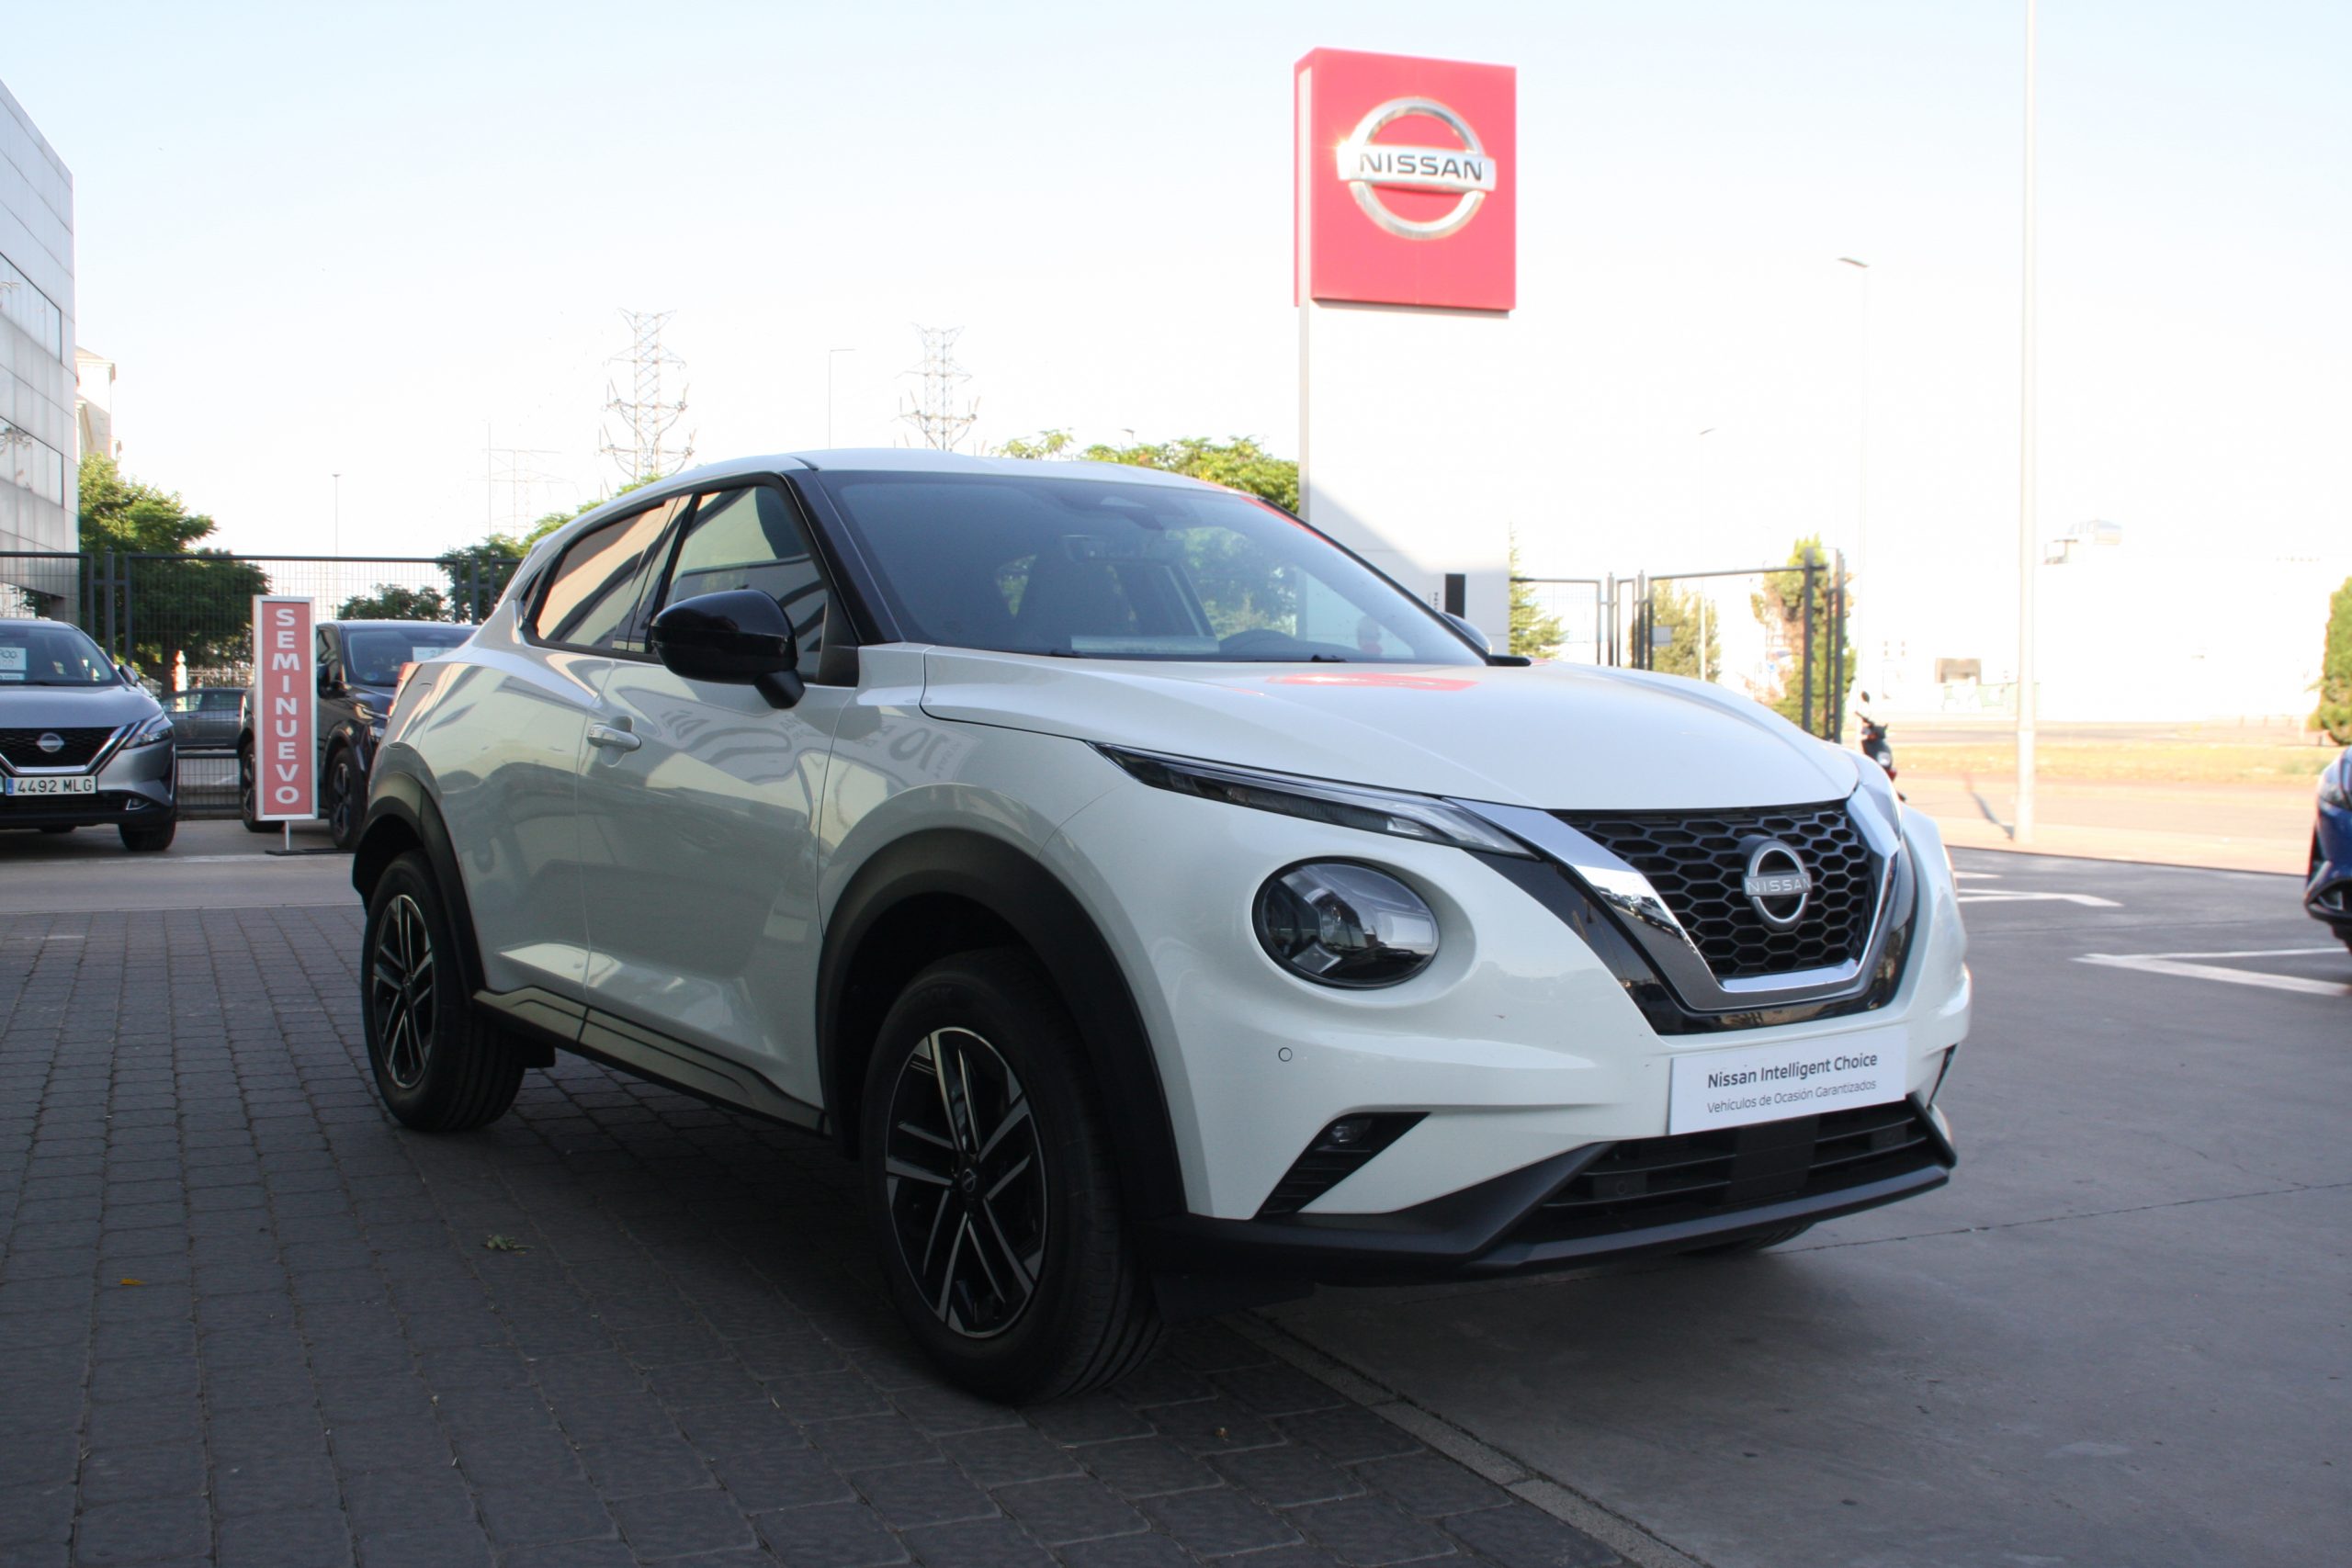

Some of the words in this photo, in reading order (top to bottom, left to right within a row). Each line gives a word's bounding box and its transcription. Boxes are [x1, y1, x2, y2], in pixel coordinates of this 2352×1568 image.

[1360, 153, 1482, 181] NISSAN
[272, 608, 300, 804] SEMINUEVO
[17, 780, 57, 793] 4492
[62, 778, 92, 792] MLG
[1747, 879, 1810, 892] NISSAN
[1708, 1071, 1757, 1089] Nissan
[1761, 1059, 1831, 1080] Intelligent
[1835, 1054, 1877, 1071] Choice
[1758, 1094, 1772, 1106] de
[1773, 1088, 1814, 1103] Ocasión
[1815, 1080, 1876, 1098] Garantizados
